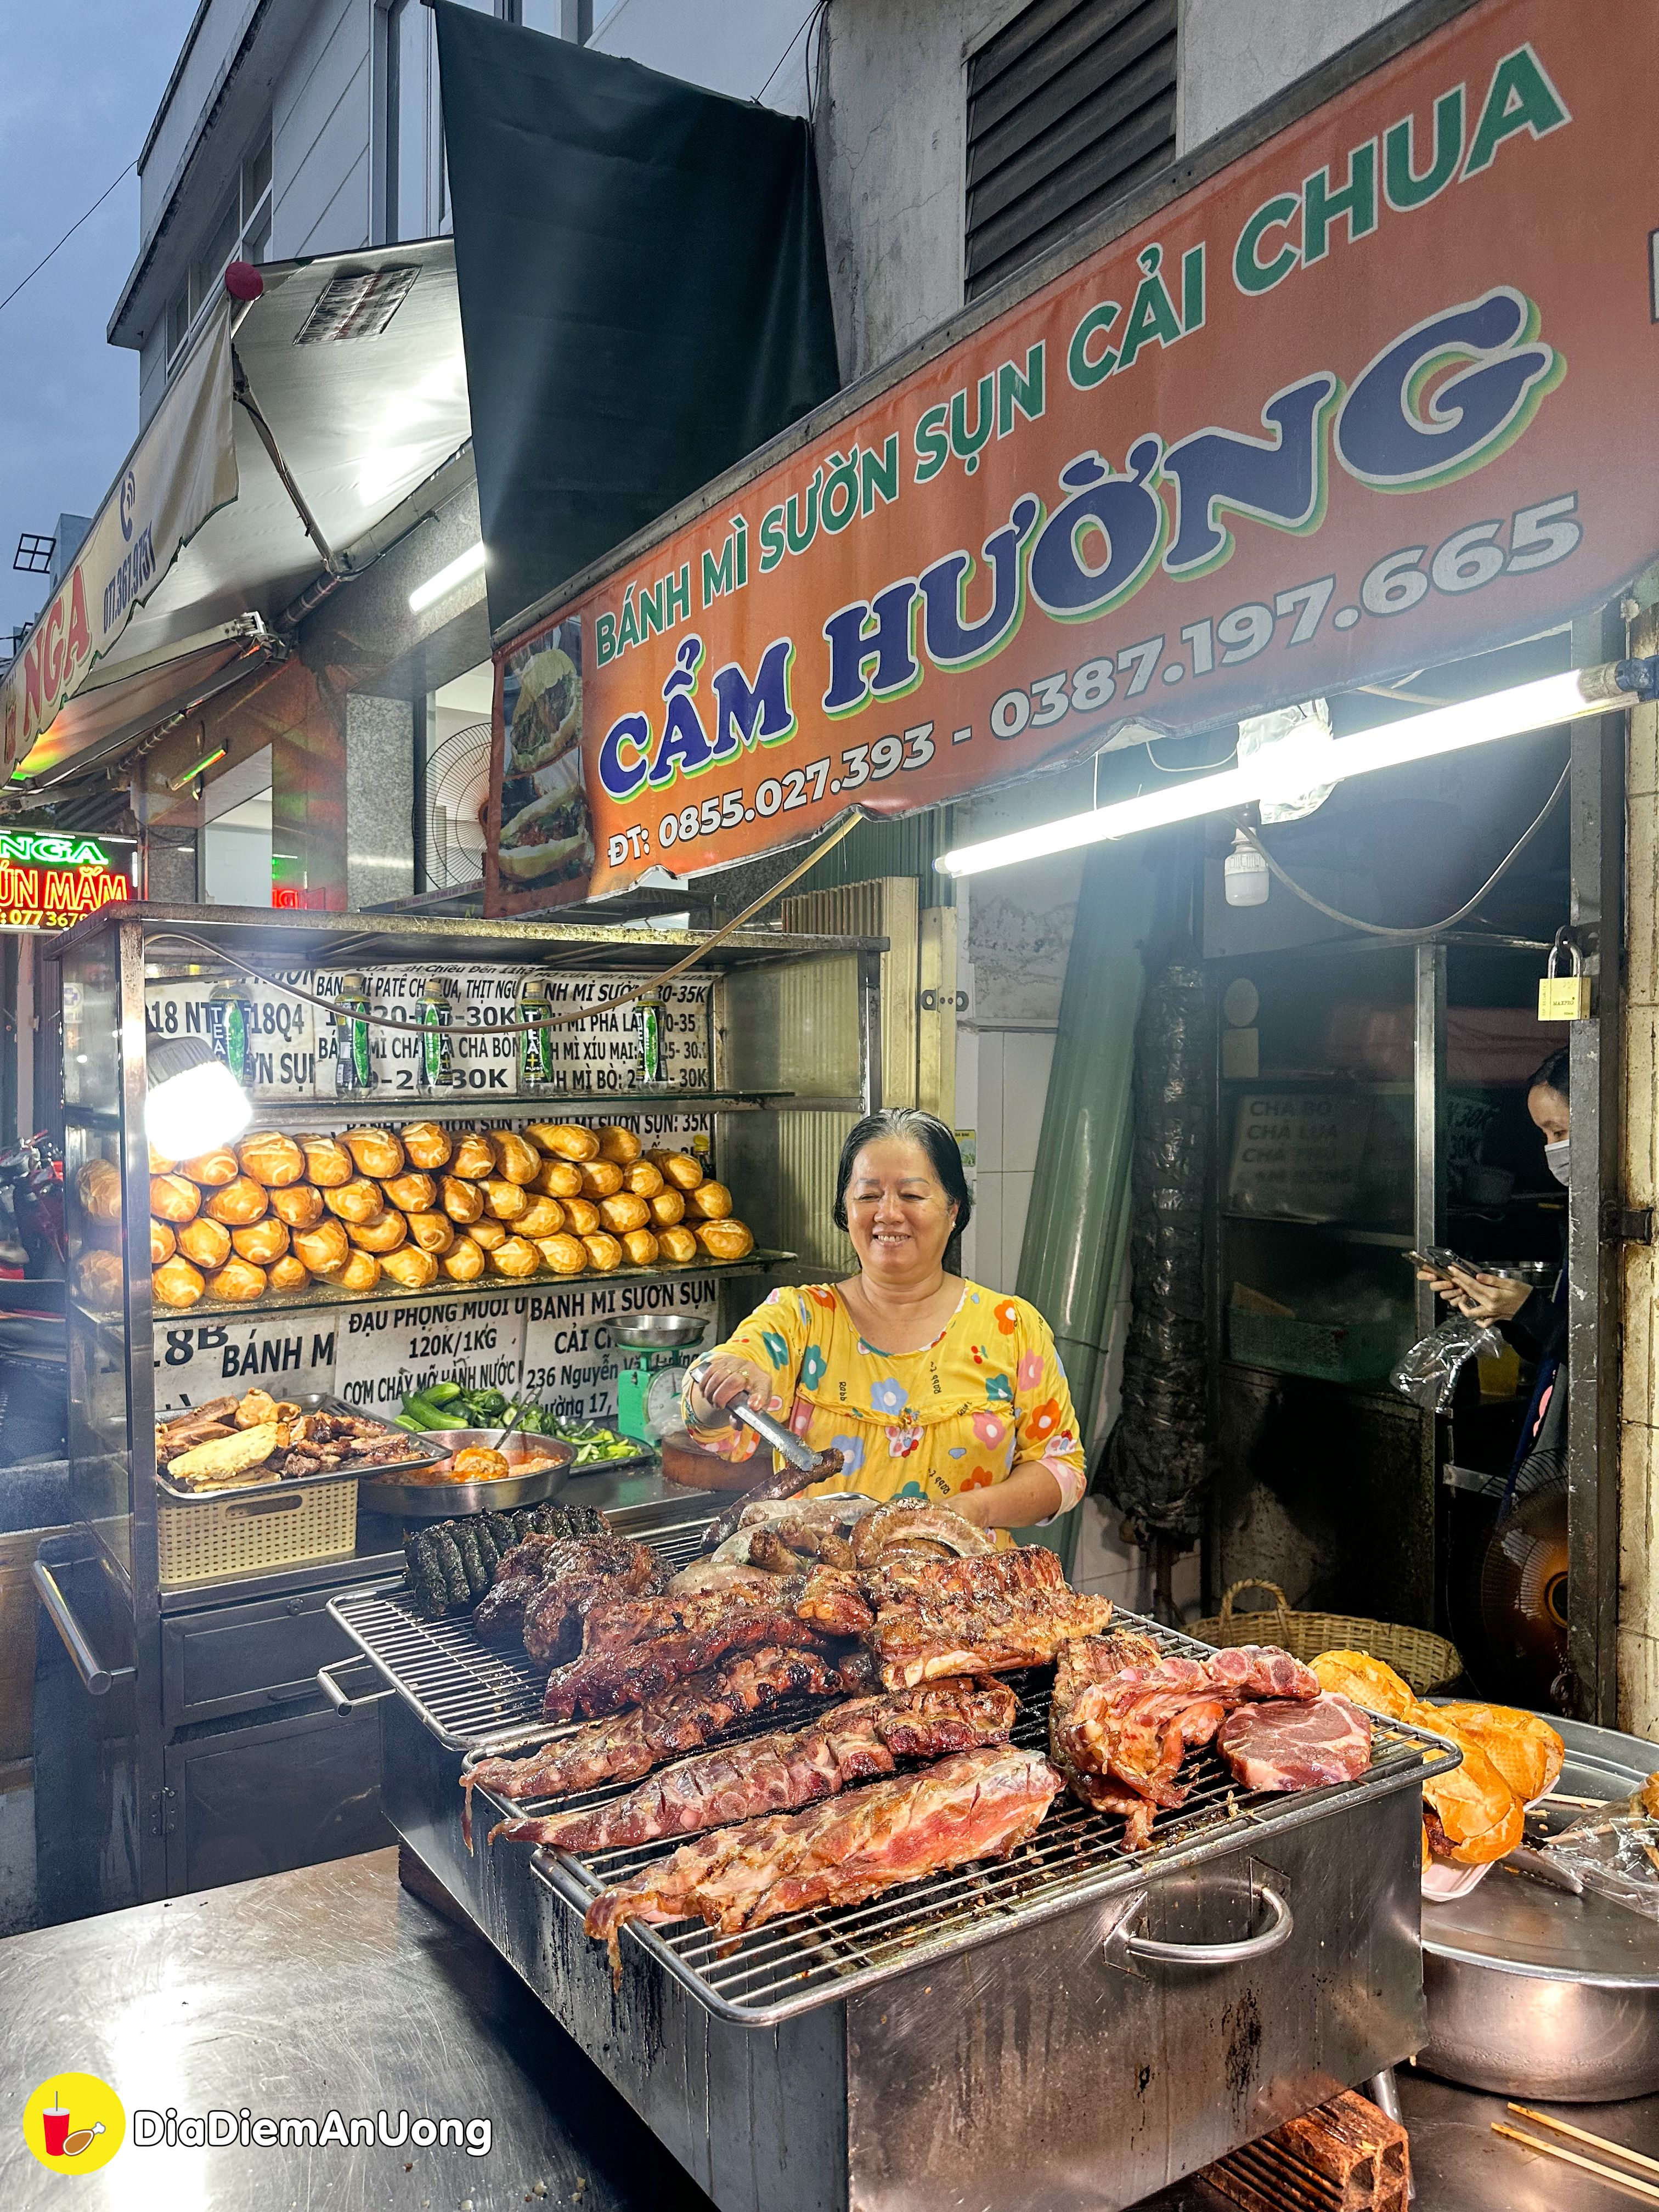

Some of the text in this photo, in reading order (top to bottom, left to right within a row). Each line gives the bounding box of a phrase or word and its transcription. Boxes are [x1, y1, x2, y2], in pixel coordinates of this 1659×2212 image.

[596, 561, 691, 669] BÁNH
[701, 514, 749, 610] MÌ
[758, 431, 900, 574] SƯỜN
[913, 338, 1046, 484] SỤN
[1066, 240, 1206, 391] CẢI
[1232, 41, 1573, 297] CHUA
[599, 285, 1567, 803] CẨM HƯỜNG
[23, 565, 92, 741] NGA
[607, 824, 651, 868] ĐT:
[658, 721, 936, 849] 0855.027.393
[990, 490, 1584, 740] 0387.197.665
[0, 835, 109, 865] NGA
[44, 866, 128, 911] MẮM
[9, 910, 44, 926] 077
[317, 973, 345, 996] BÁN
[375, 973, 407, 997] PATÊ
[466, 979, 494, 1004] THỊT
[563, 1036, 580, 1060] MÌ
[584, 1036, 606, 1060] XÍU
[573, 1063, 592, 1090] MÌ
[682, 1113, 709, 1132] 35K
[222, 1329, 302, 1378] BÁNH
[311, 1332, 336, 1368] M
[409, 1327, 498, 1359] 120K/1KG
[554, 1322, 589, 1354] CẢI
[526, 1366, 556, 1390] 236
[561, 1353, 618, 1389] Nguyễn
